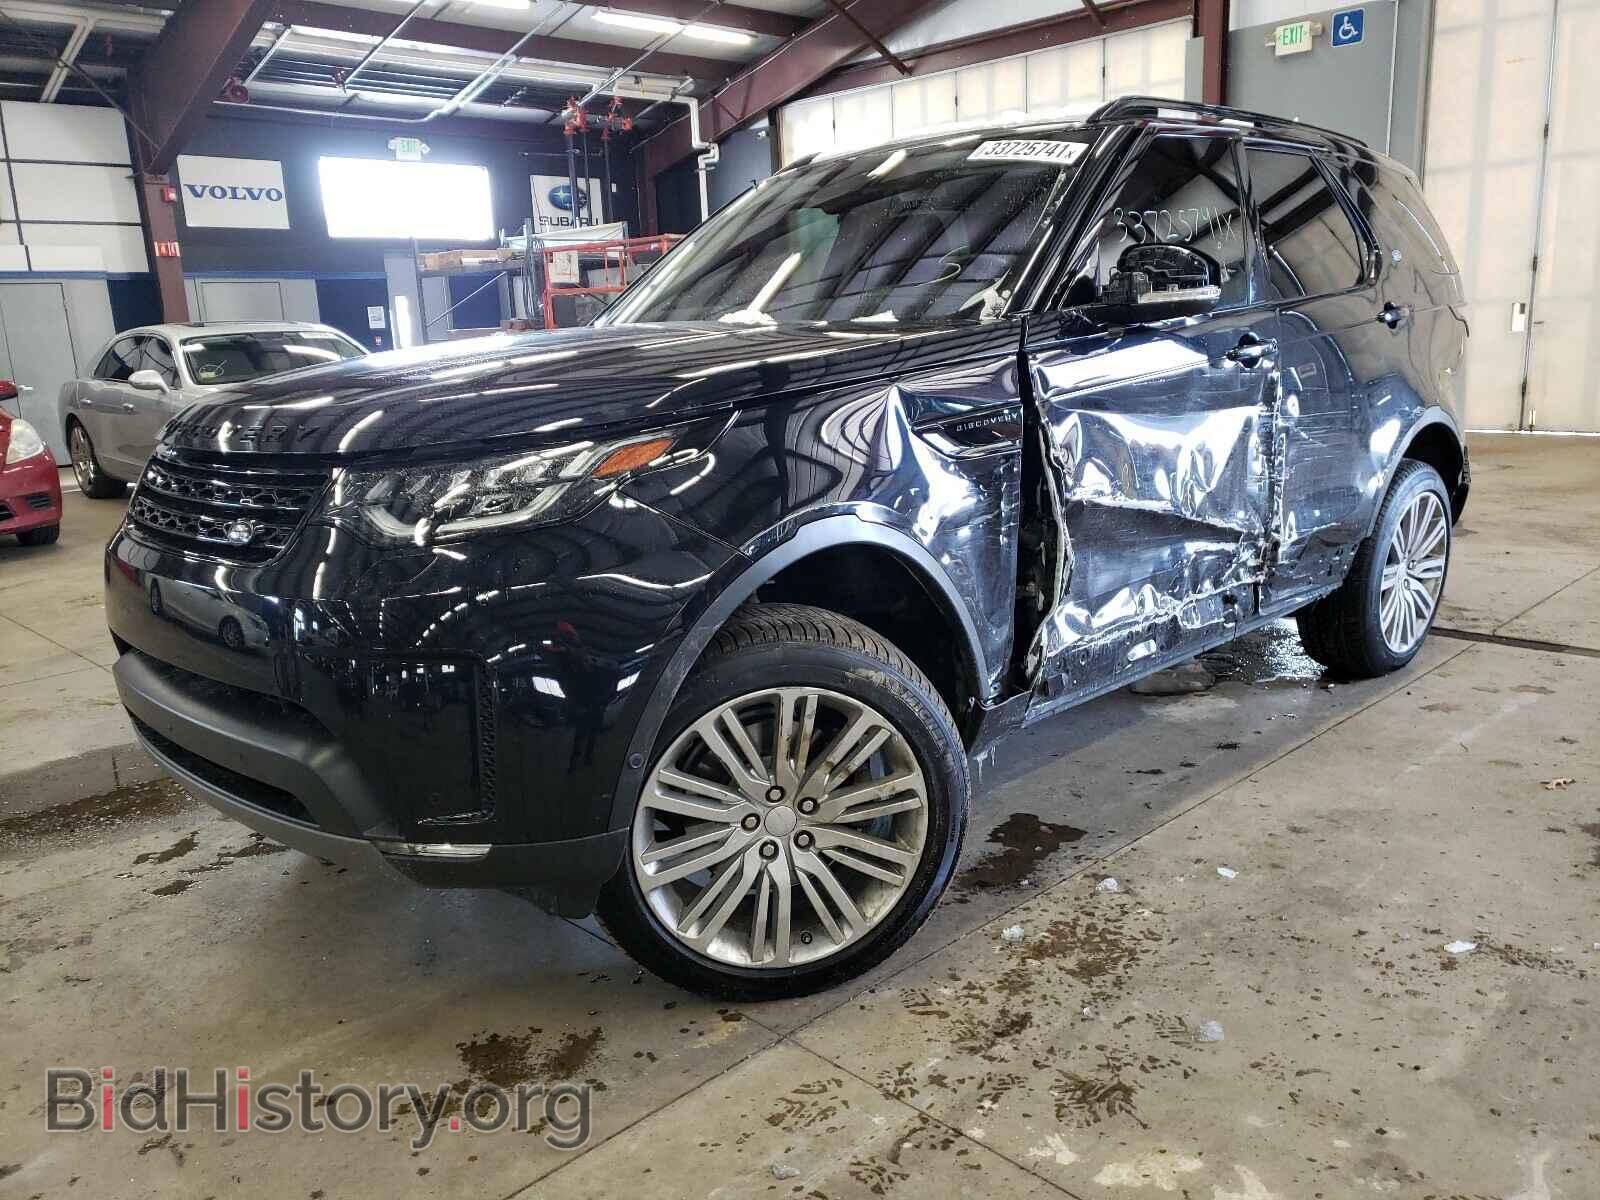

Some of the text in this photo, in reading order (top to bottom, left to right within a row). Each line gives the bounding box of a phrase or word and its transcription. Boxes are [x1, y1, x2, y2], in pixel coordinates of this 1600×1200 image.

[1282, 25, 1304, 46] EXIT
[184, 184, 283, 201] VOLVO
[956, 412, 1018, 432] DISCOVERY
